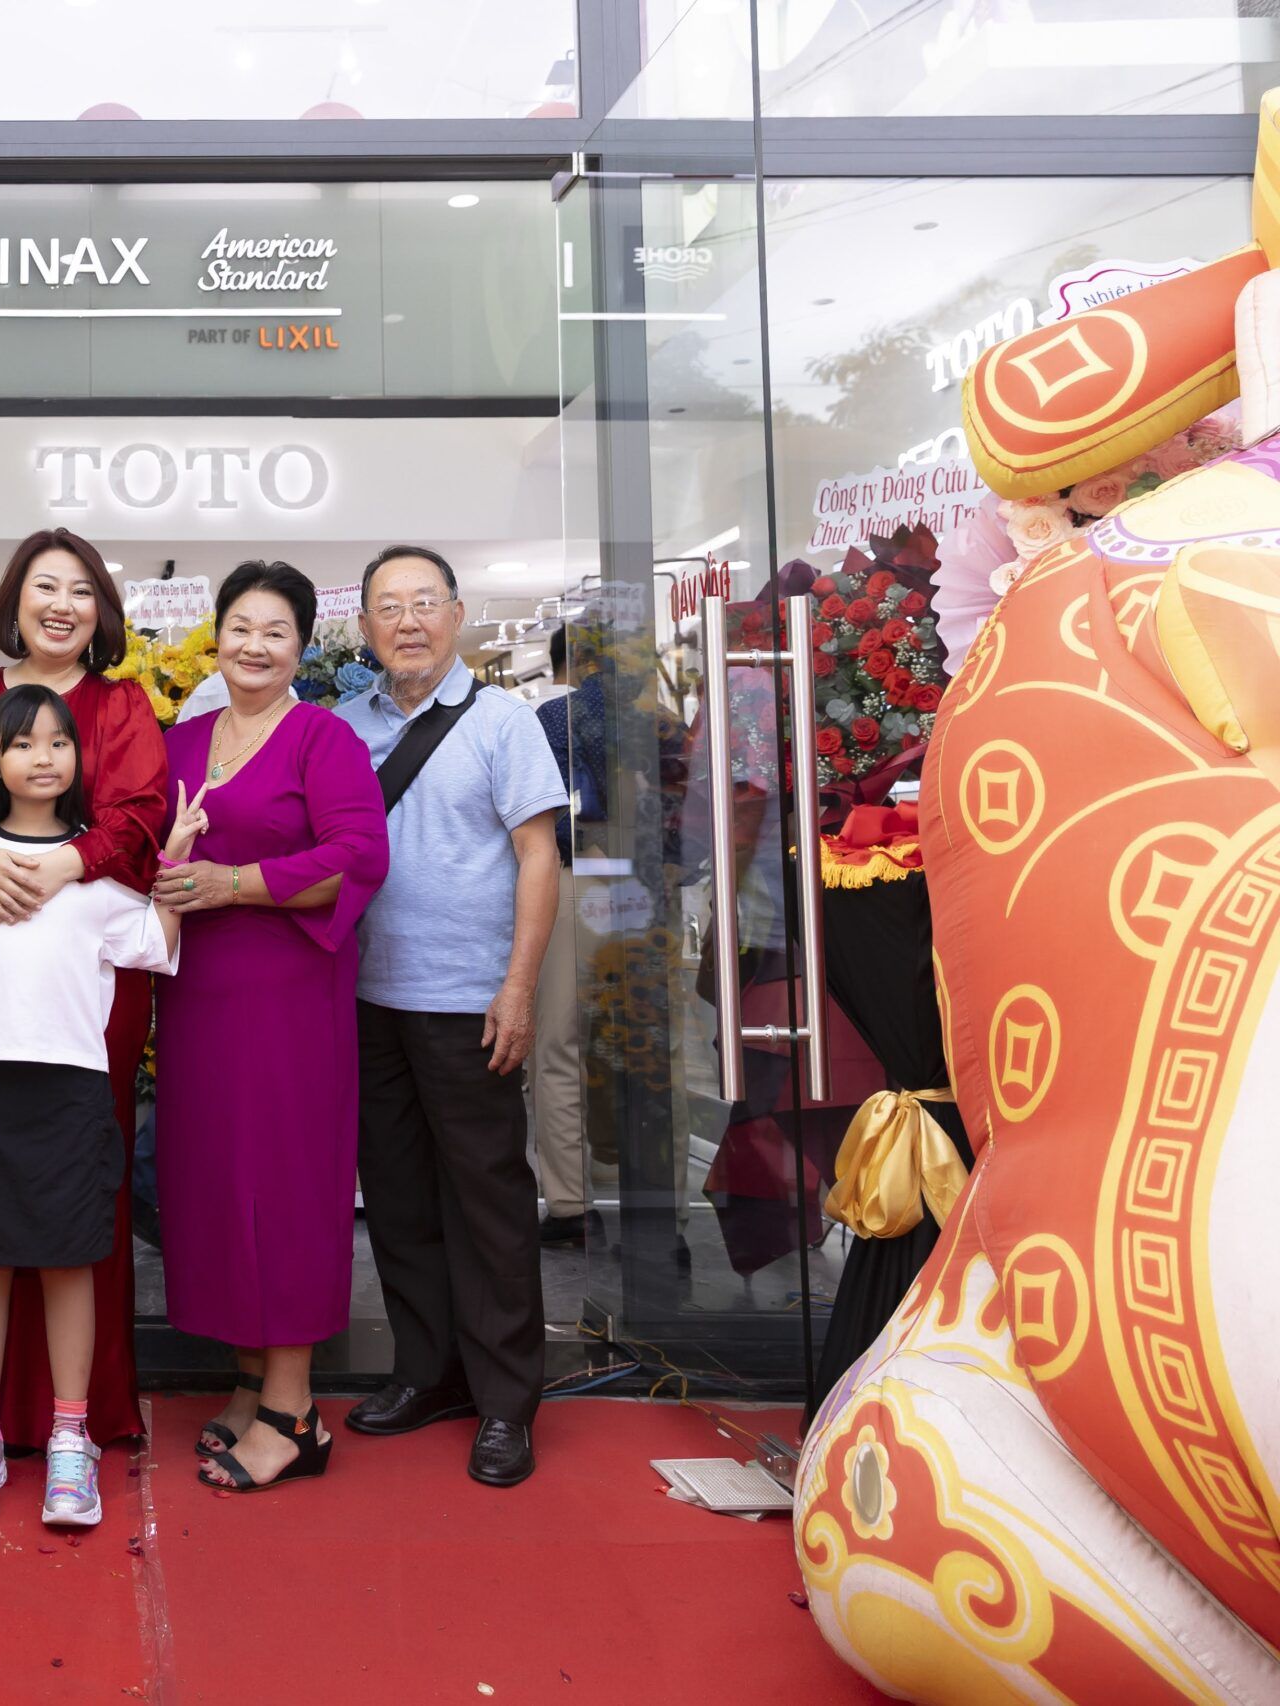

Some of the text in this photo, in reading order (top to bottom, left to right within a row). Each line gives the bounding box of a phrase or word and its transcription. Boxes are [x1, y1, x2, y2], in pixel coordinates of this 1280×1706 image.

[200, 227, 338, 259] American
[0, 237, 150, 285] INAX
[197, 259, 330, 291] Standard
[188, 324, 340, 350] PART OF LIXIL
[35, 442, 329, 510] TOTO
[820, 481, 858, 516] Công
[811, 516, 853, 547] Chúc
[315, 583, 362, 597] Casagrand
